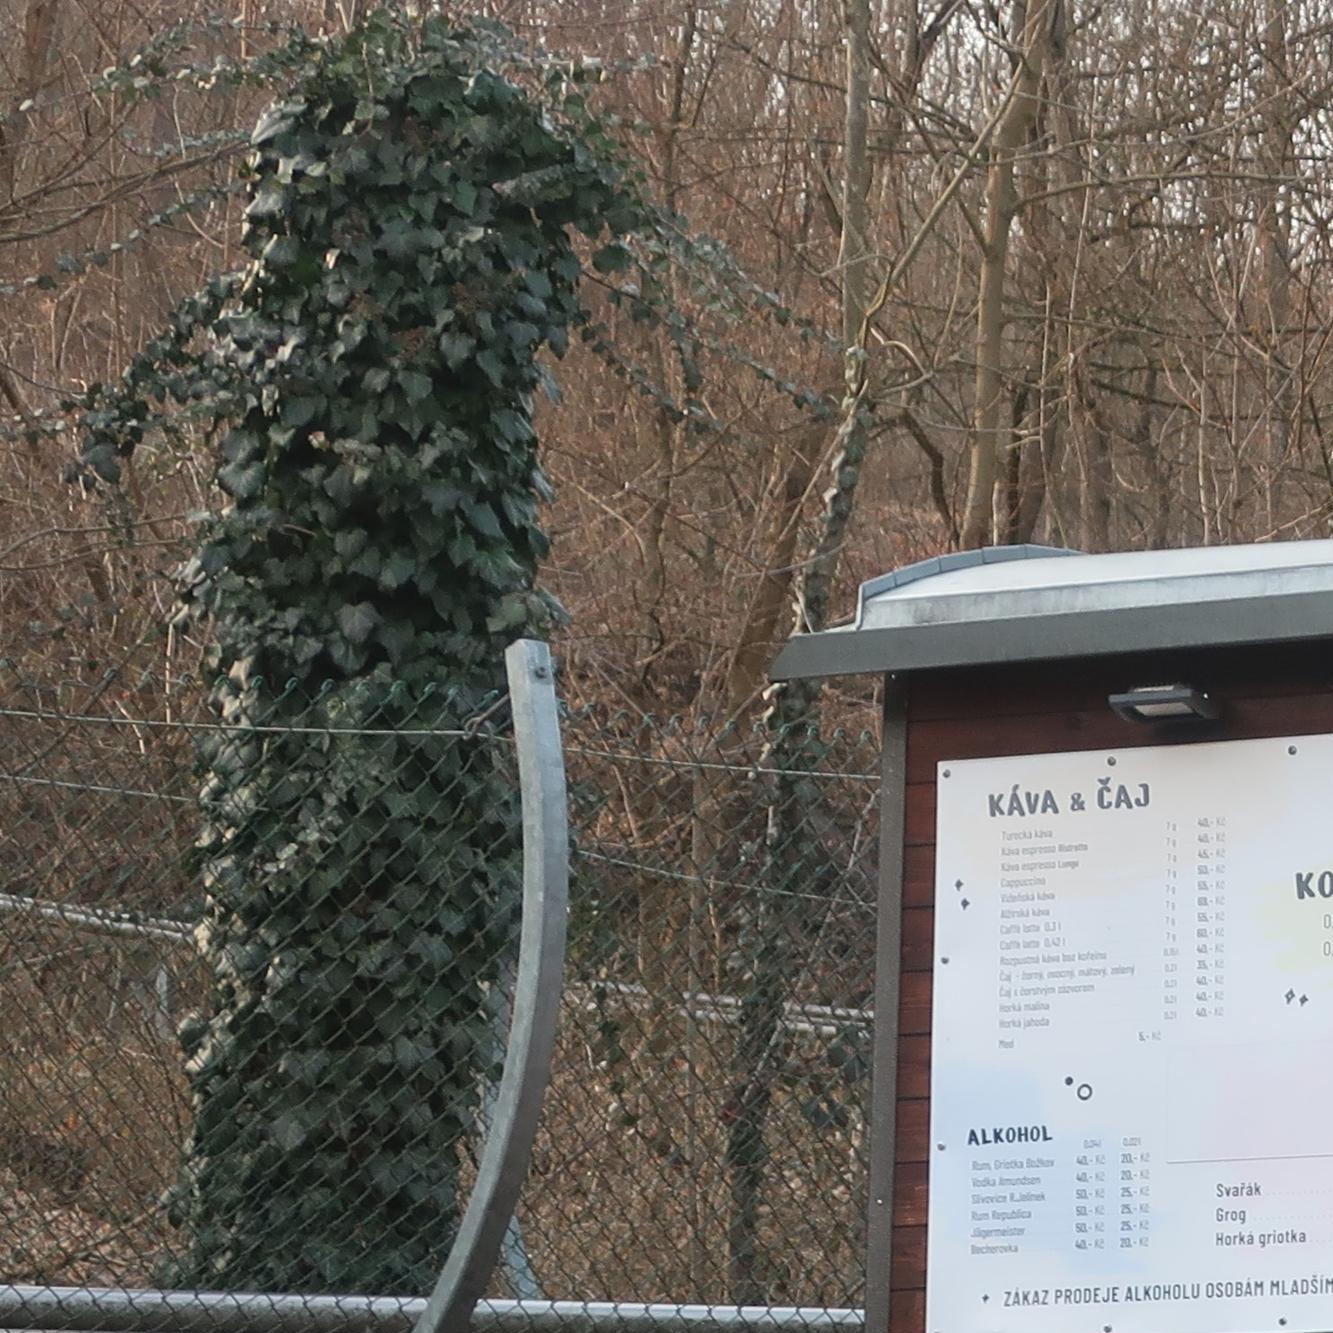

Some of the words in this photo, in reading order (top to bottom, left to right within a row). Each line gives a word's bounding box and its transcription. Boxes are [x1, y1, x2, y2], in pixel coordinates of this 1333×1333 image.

[988, 784, 1059, 817] KÁVA
[1070, 793, 1085, 811] &
[1097, 777, 1150, 810] ČAJ
[967, 1125, 1053, 1146] ALKOHOL
[1216, 1182, 1262, 1198] Svařák
[1216, 1207, 1246, 1225] Grog
[1215, 1231, 1255, 1247] Horká
[1259, 1229, 1307, 1248] griotka
[1003, 1287, 1049, 1307] ZÁKAZ
[1054, 1287, 1119, 1304] PRODEJE
[1124, 1283, 1200, 1302] ALKOHOLU
[1205, 1277, 1264, 1298] OSOBÁM
